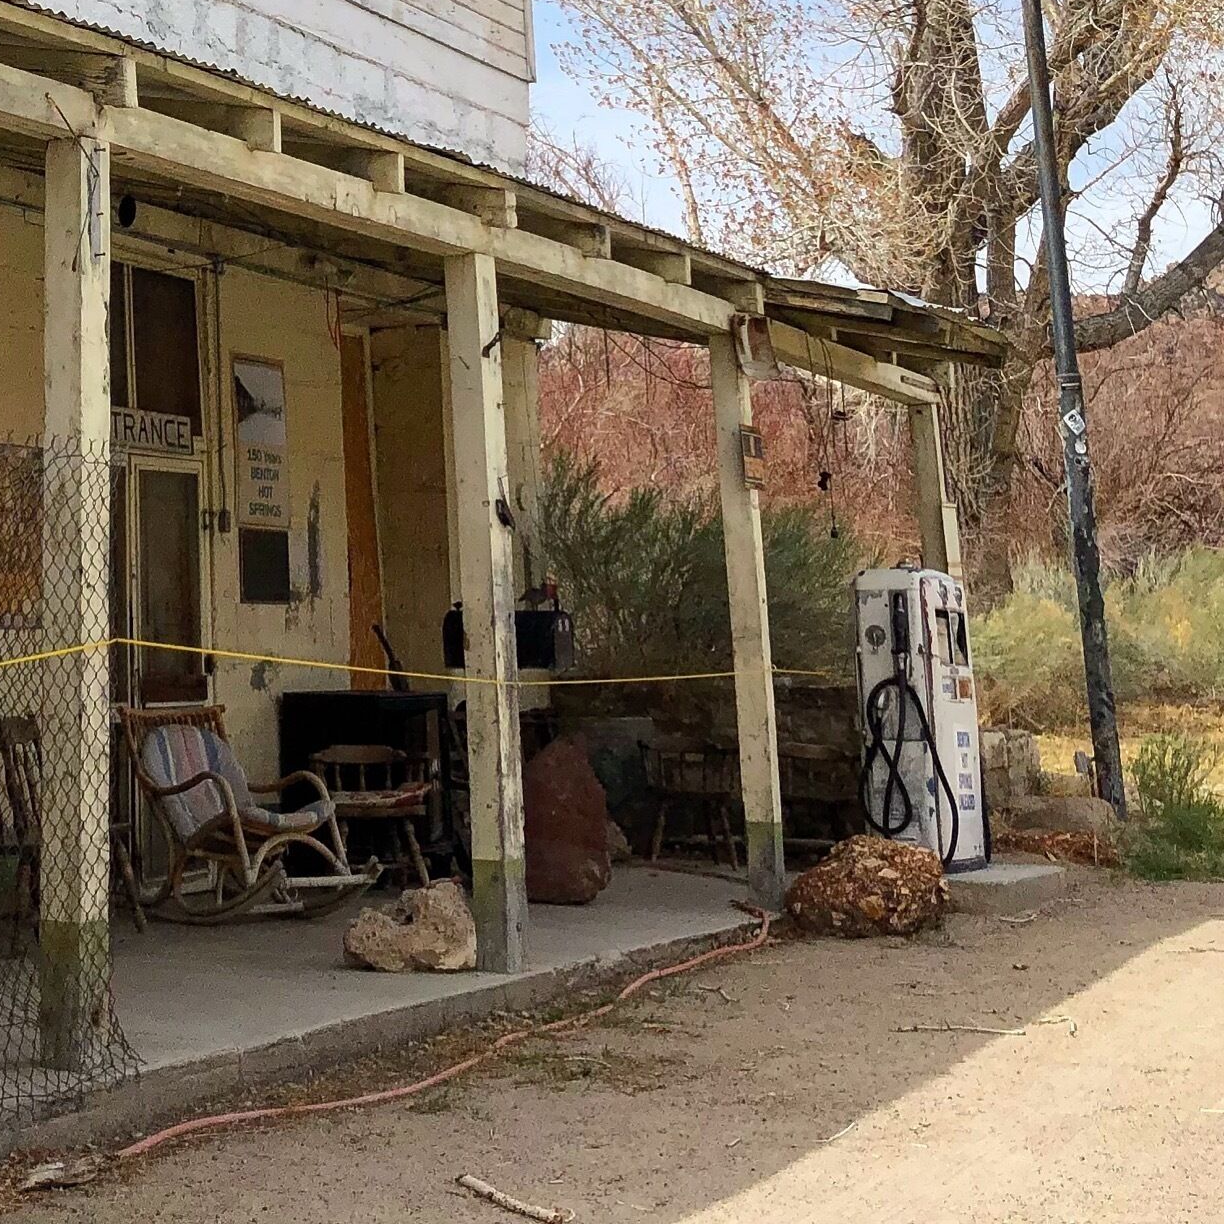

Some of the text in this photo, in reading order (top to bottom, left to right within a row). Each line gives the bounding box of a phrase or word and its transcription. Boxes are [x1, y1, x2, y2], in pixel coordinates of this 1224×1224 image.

[111, 411, 190, 449] TRANCE
[250, 466, 280, 482] BENTON
[258, 484, 273, 499] HOT
[248, 501, 282, 518] SPRINGS
